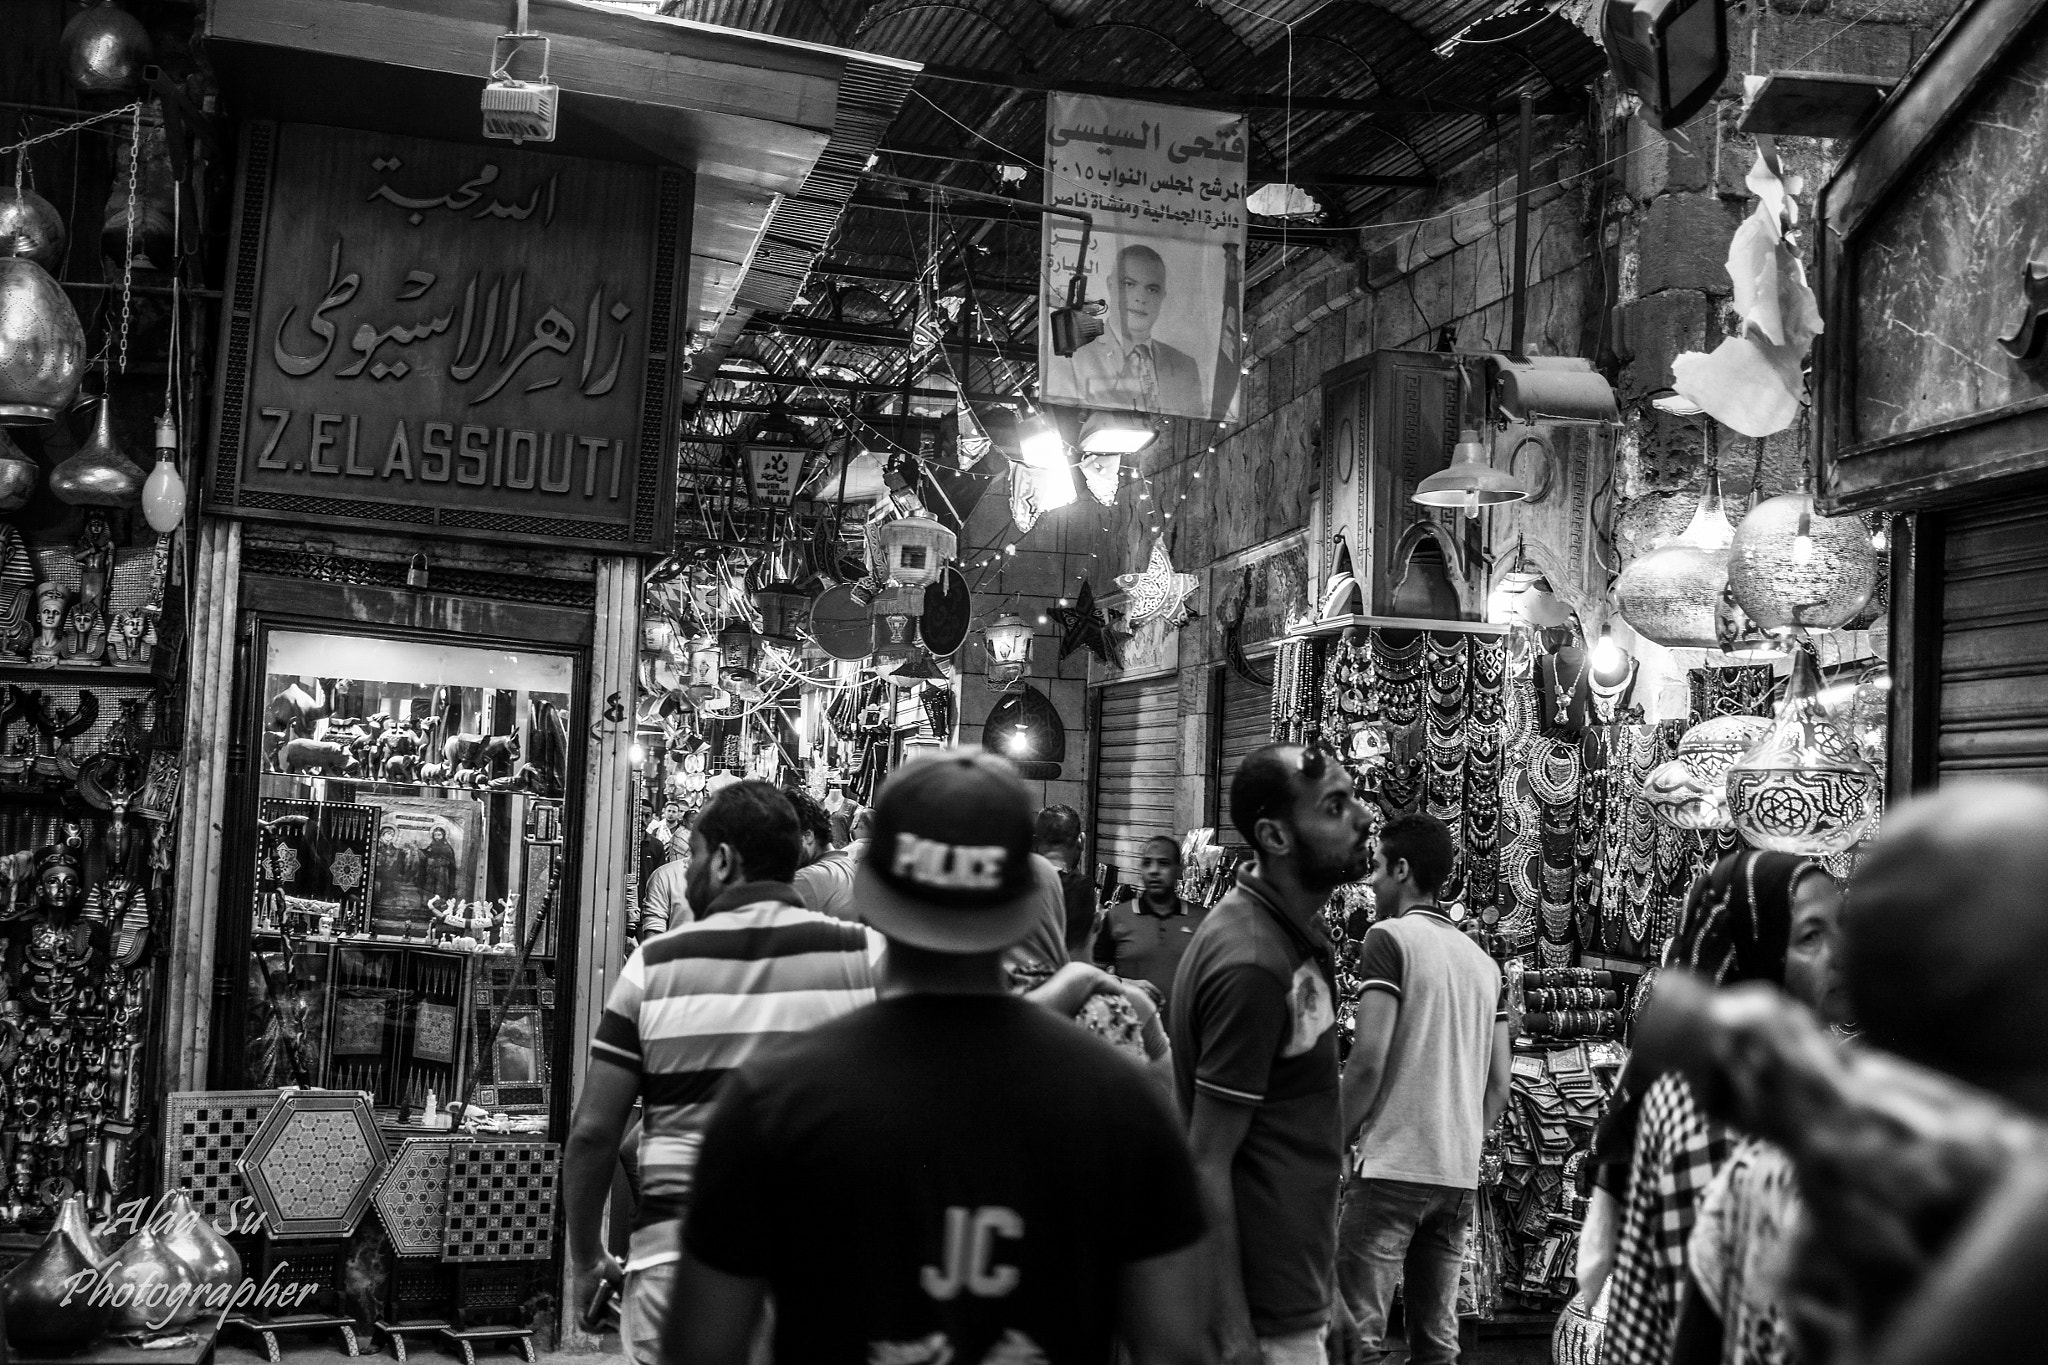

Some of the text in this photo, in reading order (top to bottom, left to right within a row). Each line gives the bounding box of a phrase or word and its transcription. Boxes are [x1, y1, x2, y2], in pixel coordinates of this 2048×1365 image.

[1097, 166, 1148, 188] النواب
[1149, 173, 1194, 196] لمجلس
[1049, 191, 1088, 207] ناصر
[1199, 177, 1246, 203] المرشح
[1142, 199, 1201, 226] الجمالية
[920, 1205, 1025, 1300] JC
